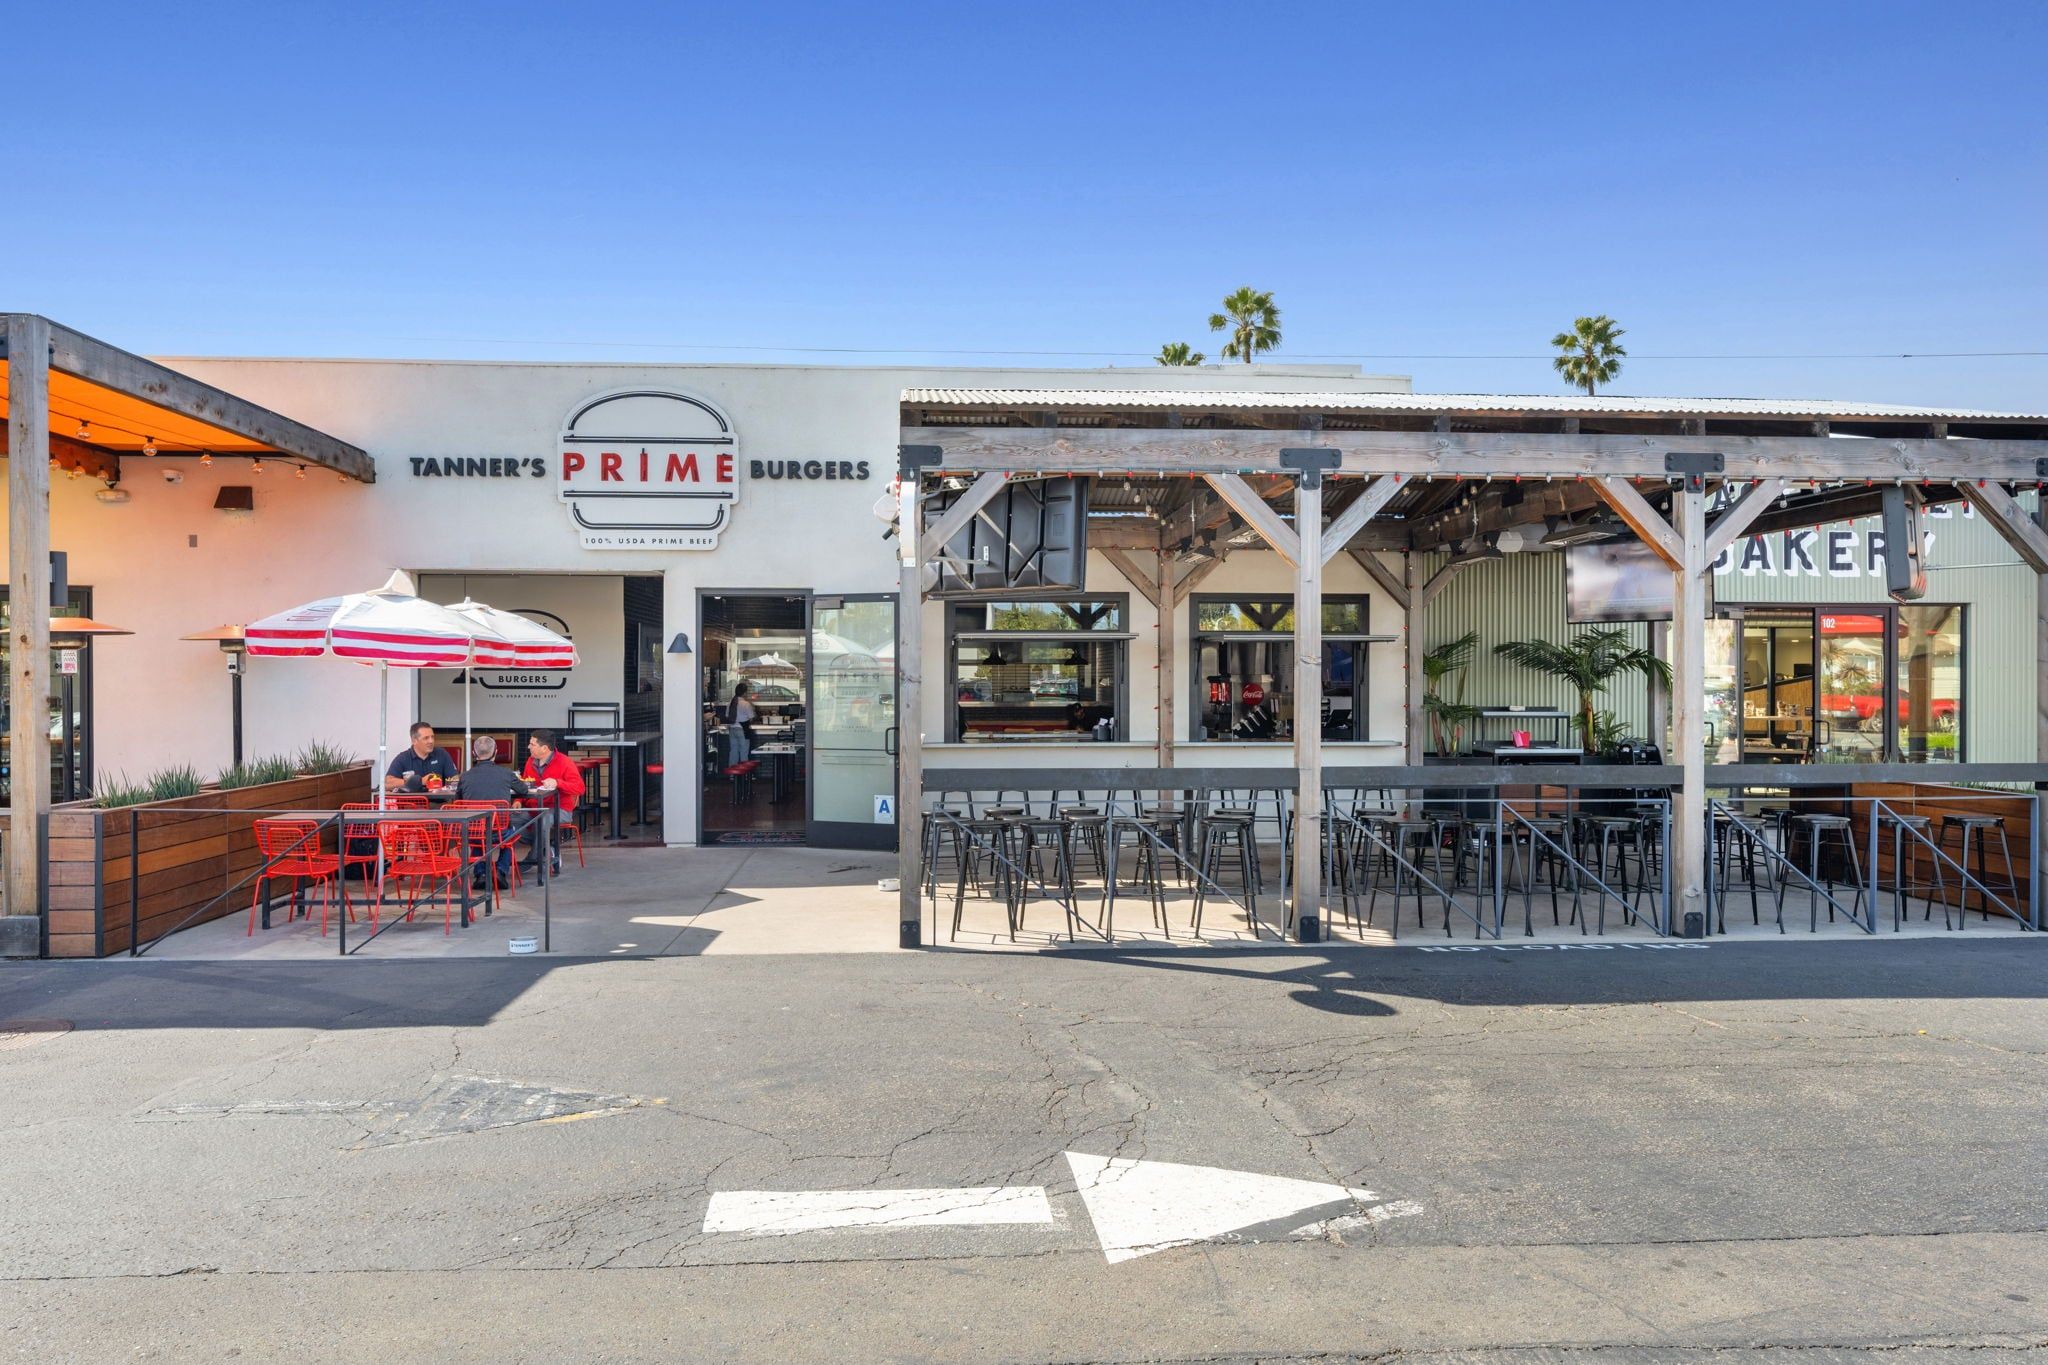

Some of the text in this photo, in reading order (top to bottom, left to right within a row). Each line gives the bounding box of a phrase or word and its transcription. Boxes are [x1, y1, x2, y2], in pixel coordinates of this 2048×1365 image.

[409, 451, 871, 483] TANNER'S PRIME BURGERS
[1713, 530, 1932, 576] AKER
[1822, 618, 1836, 628] 102
[498, 675, 548, 683] BURGERS
[879, 799, 891, 813] A
